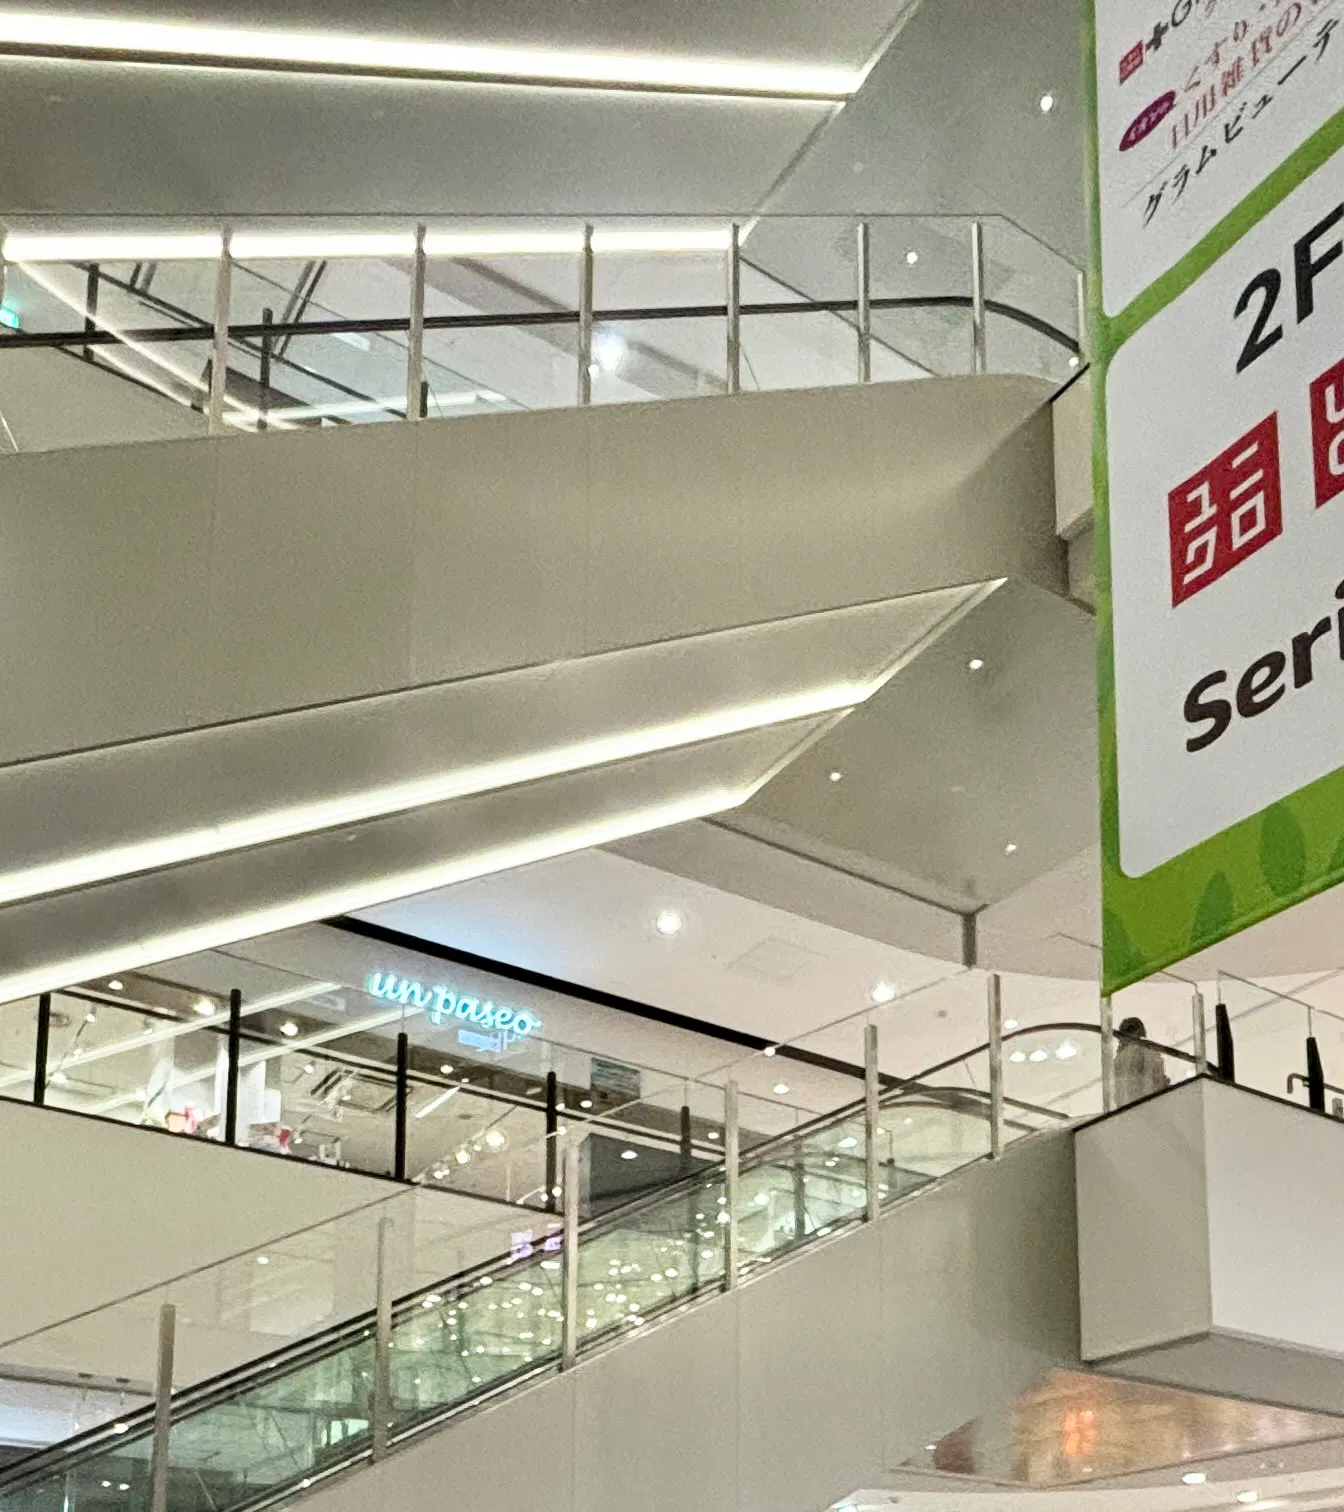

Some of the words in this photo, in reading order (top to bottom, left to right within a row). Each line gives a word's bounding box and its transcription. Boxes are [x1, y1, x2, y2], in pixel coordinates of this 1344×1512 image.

[1172, 0, 1319, 149] 日用雑貨の
[1233, 202, 1344, 374] 2F
